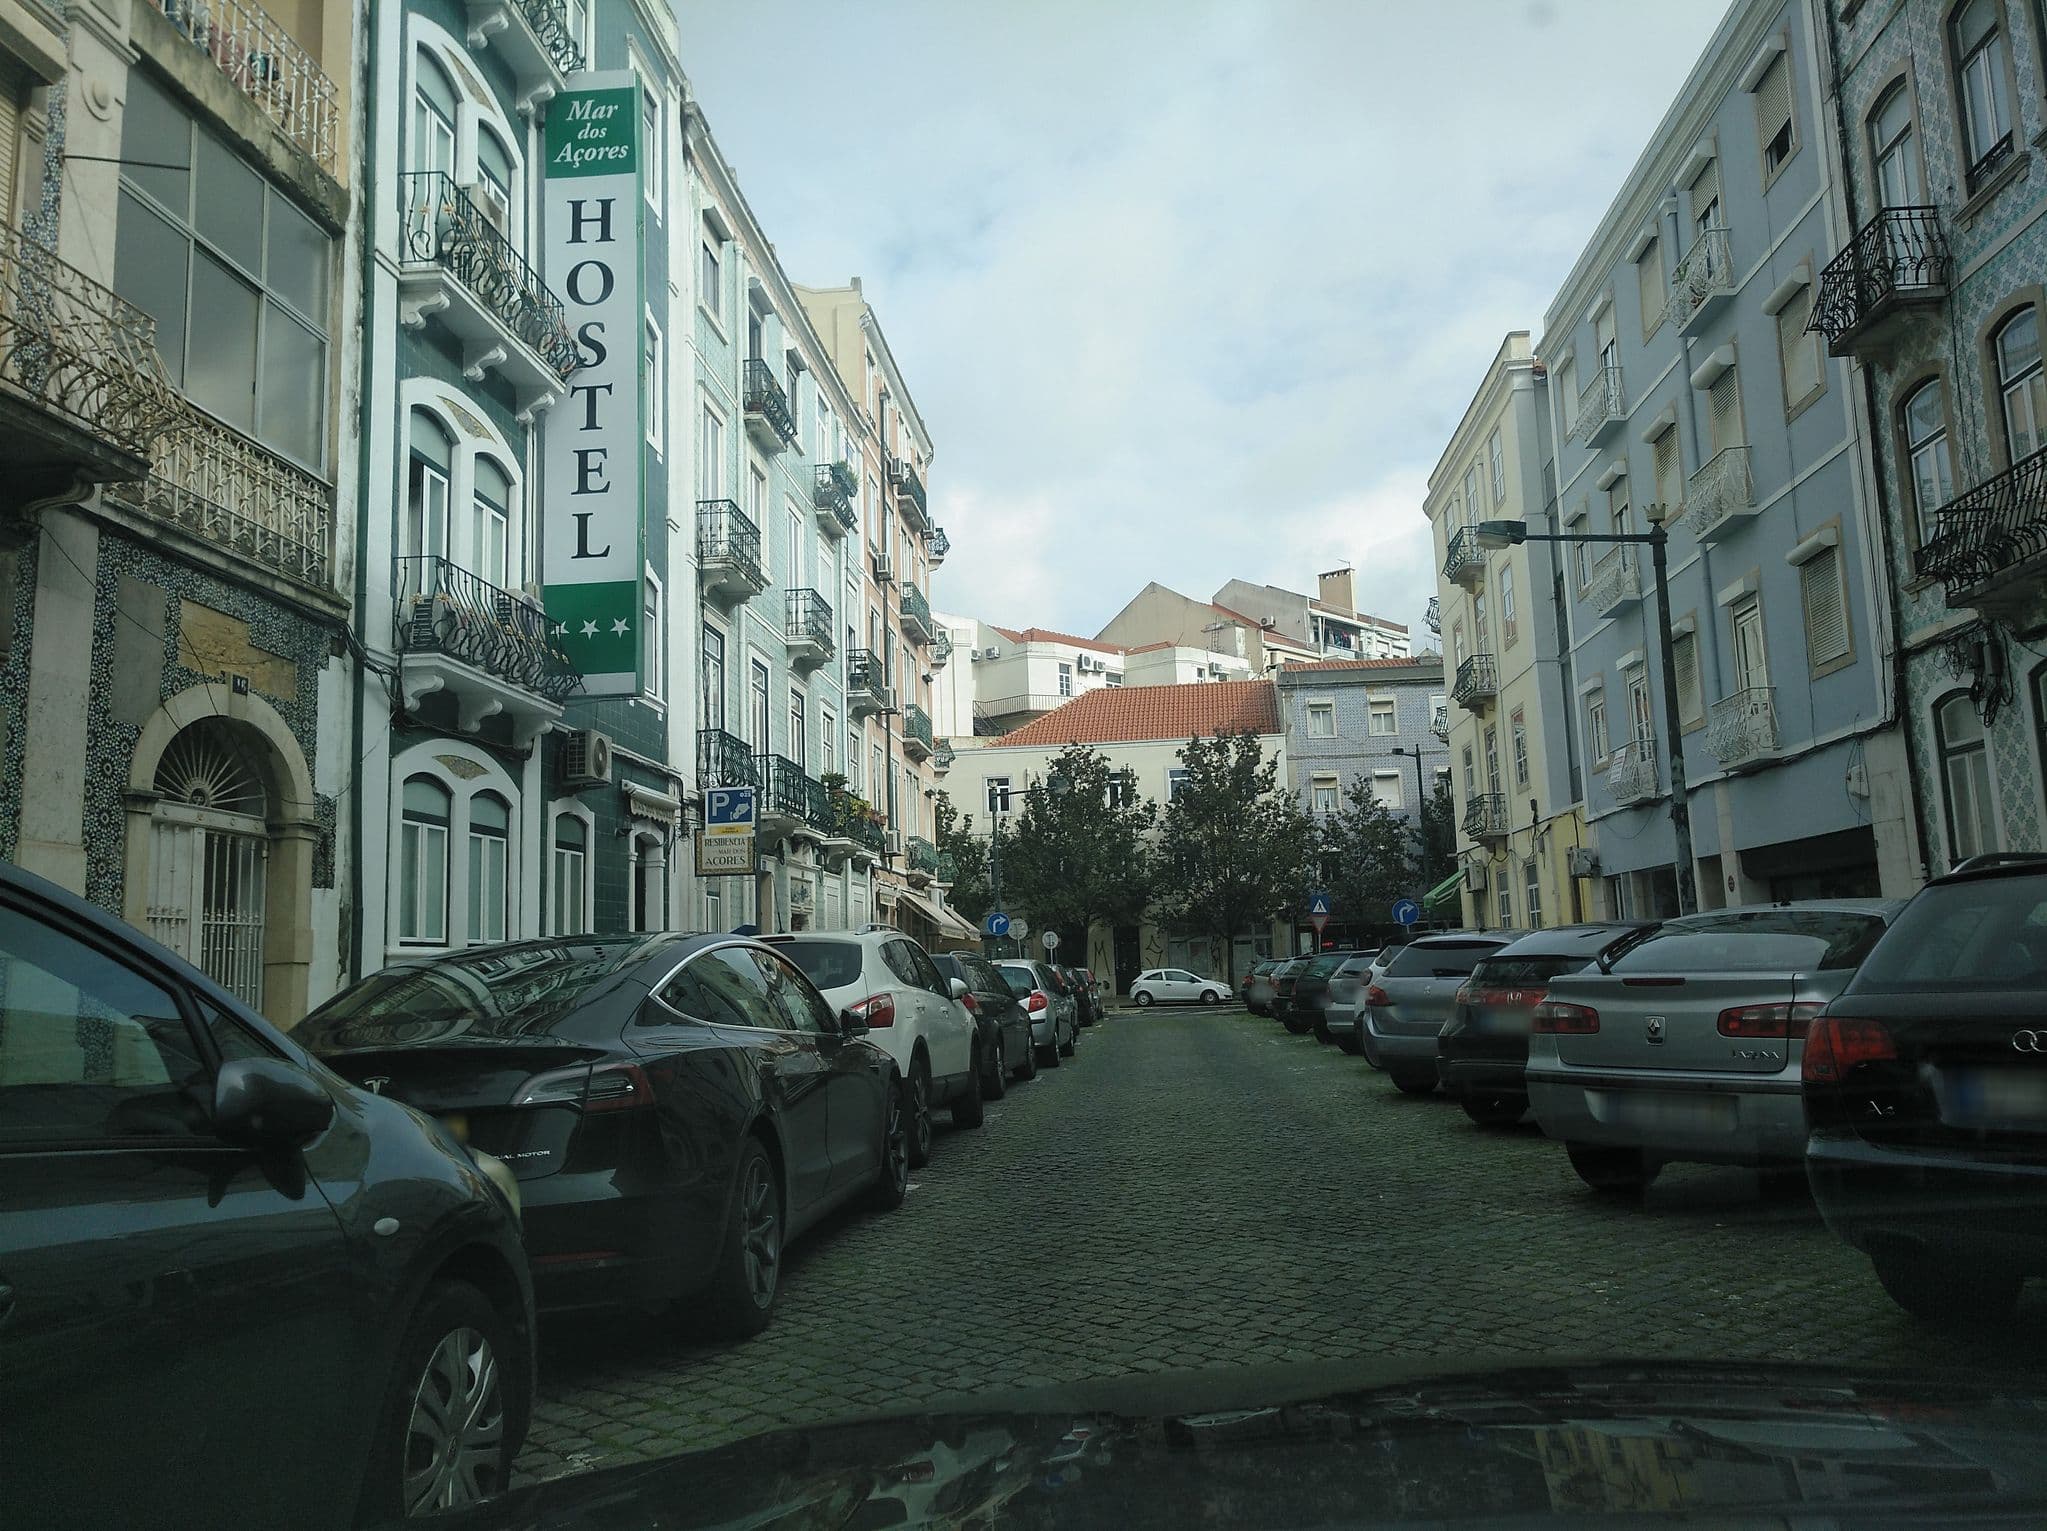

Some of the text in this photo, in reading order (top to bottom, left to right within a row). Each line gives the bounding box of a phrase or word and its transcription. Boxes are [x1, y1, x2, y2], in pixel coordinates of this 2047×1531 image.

[566, 99, 618, 121] Mar
[577, 122, 608, 140] dos
[553, 142, 629, 169] Açores
[565, 197, 617, 560] HOSTEL
[711, 792, 730, 817] P
[517, 1150, 551, 1158] MOTOR
